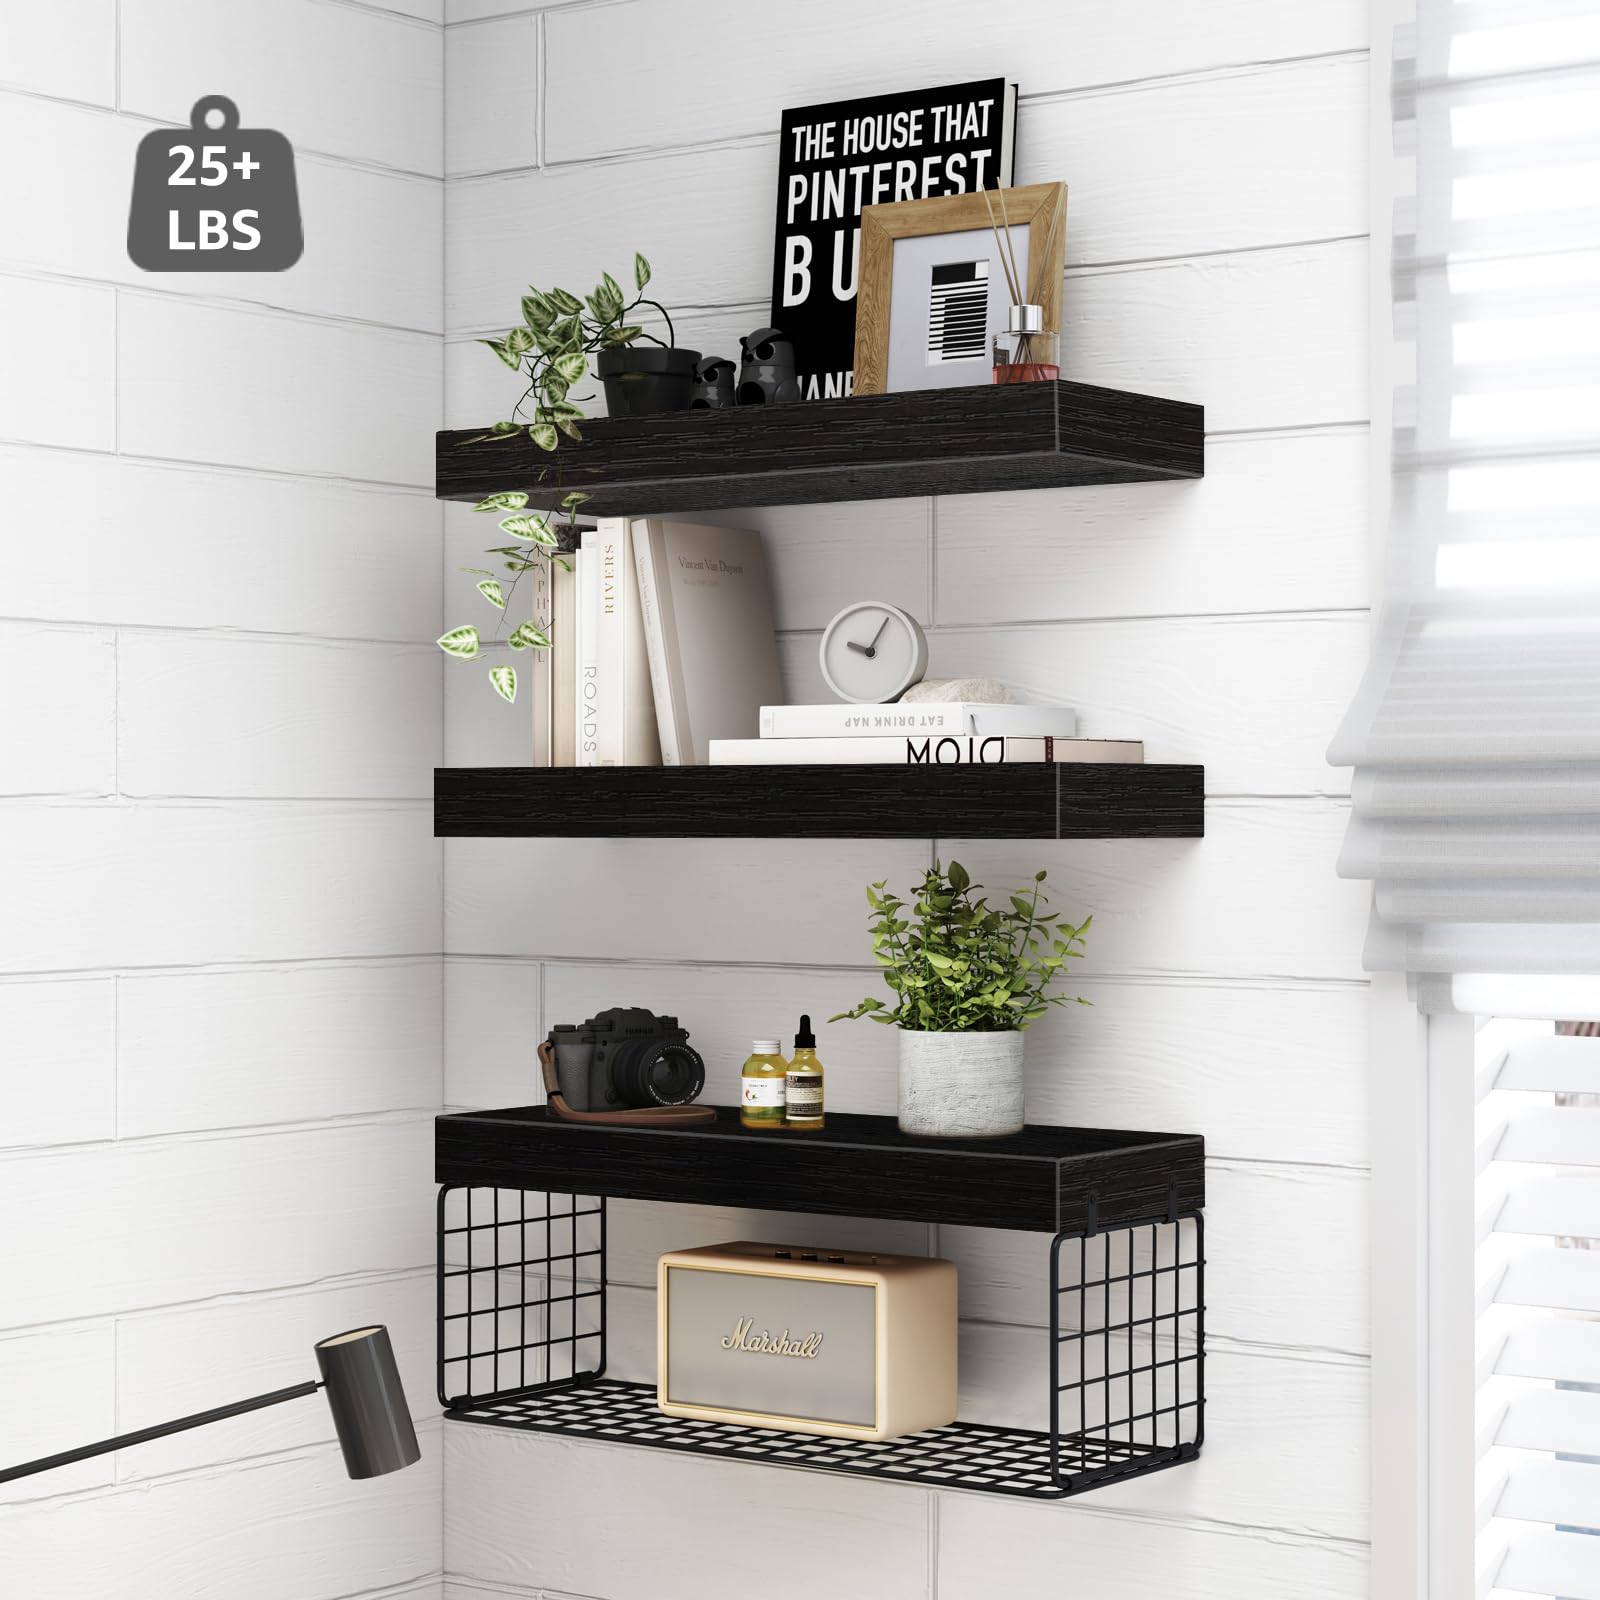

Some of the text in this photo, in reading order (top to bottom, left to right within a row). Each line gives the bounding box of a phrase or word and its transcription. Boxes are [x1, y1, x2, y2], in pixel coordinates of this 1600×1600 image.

[791, 99, 994, 163] THE HOUSE THAT
[786, 149, 993, 225] PINTEREST
[536, 545, 547, 663] RAPHAL
[604, 544, 615, 615] RIVERS
[583, 665, 597, 753] ROADS
[844, 715, 944, 728] EAT DRINK NAP
[720, 1316, 824, 1359] Marshall
